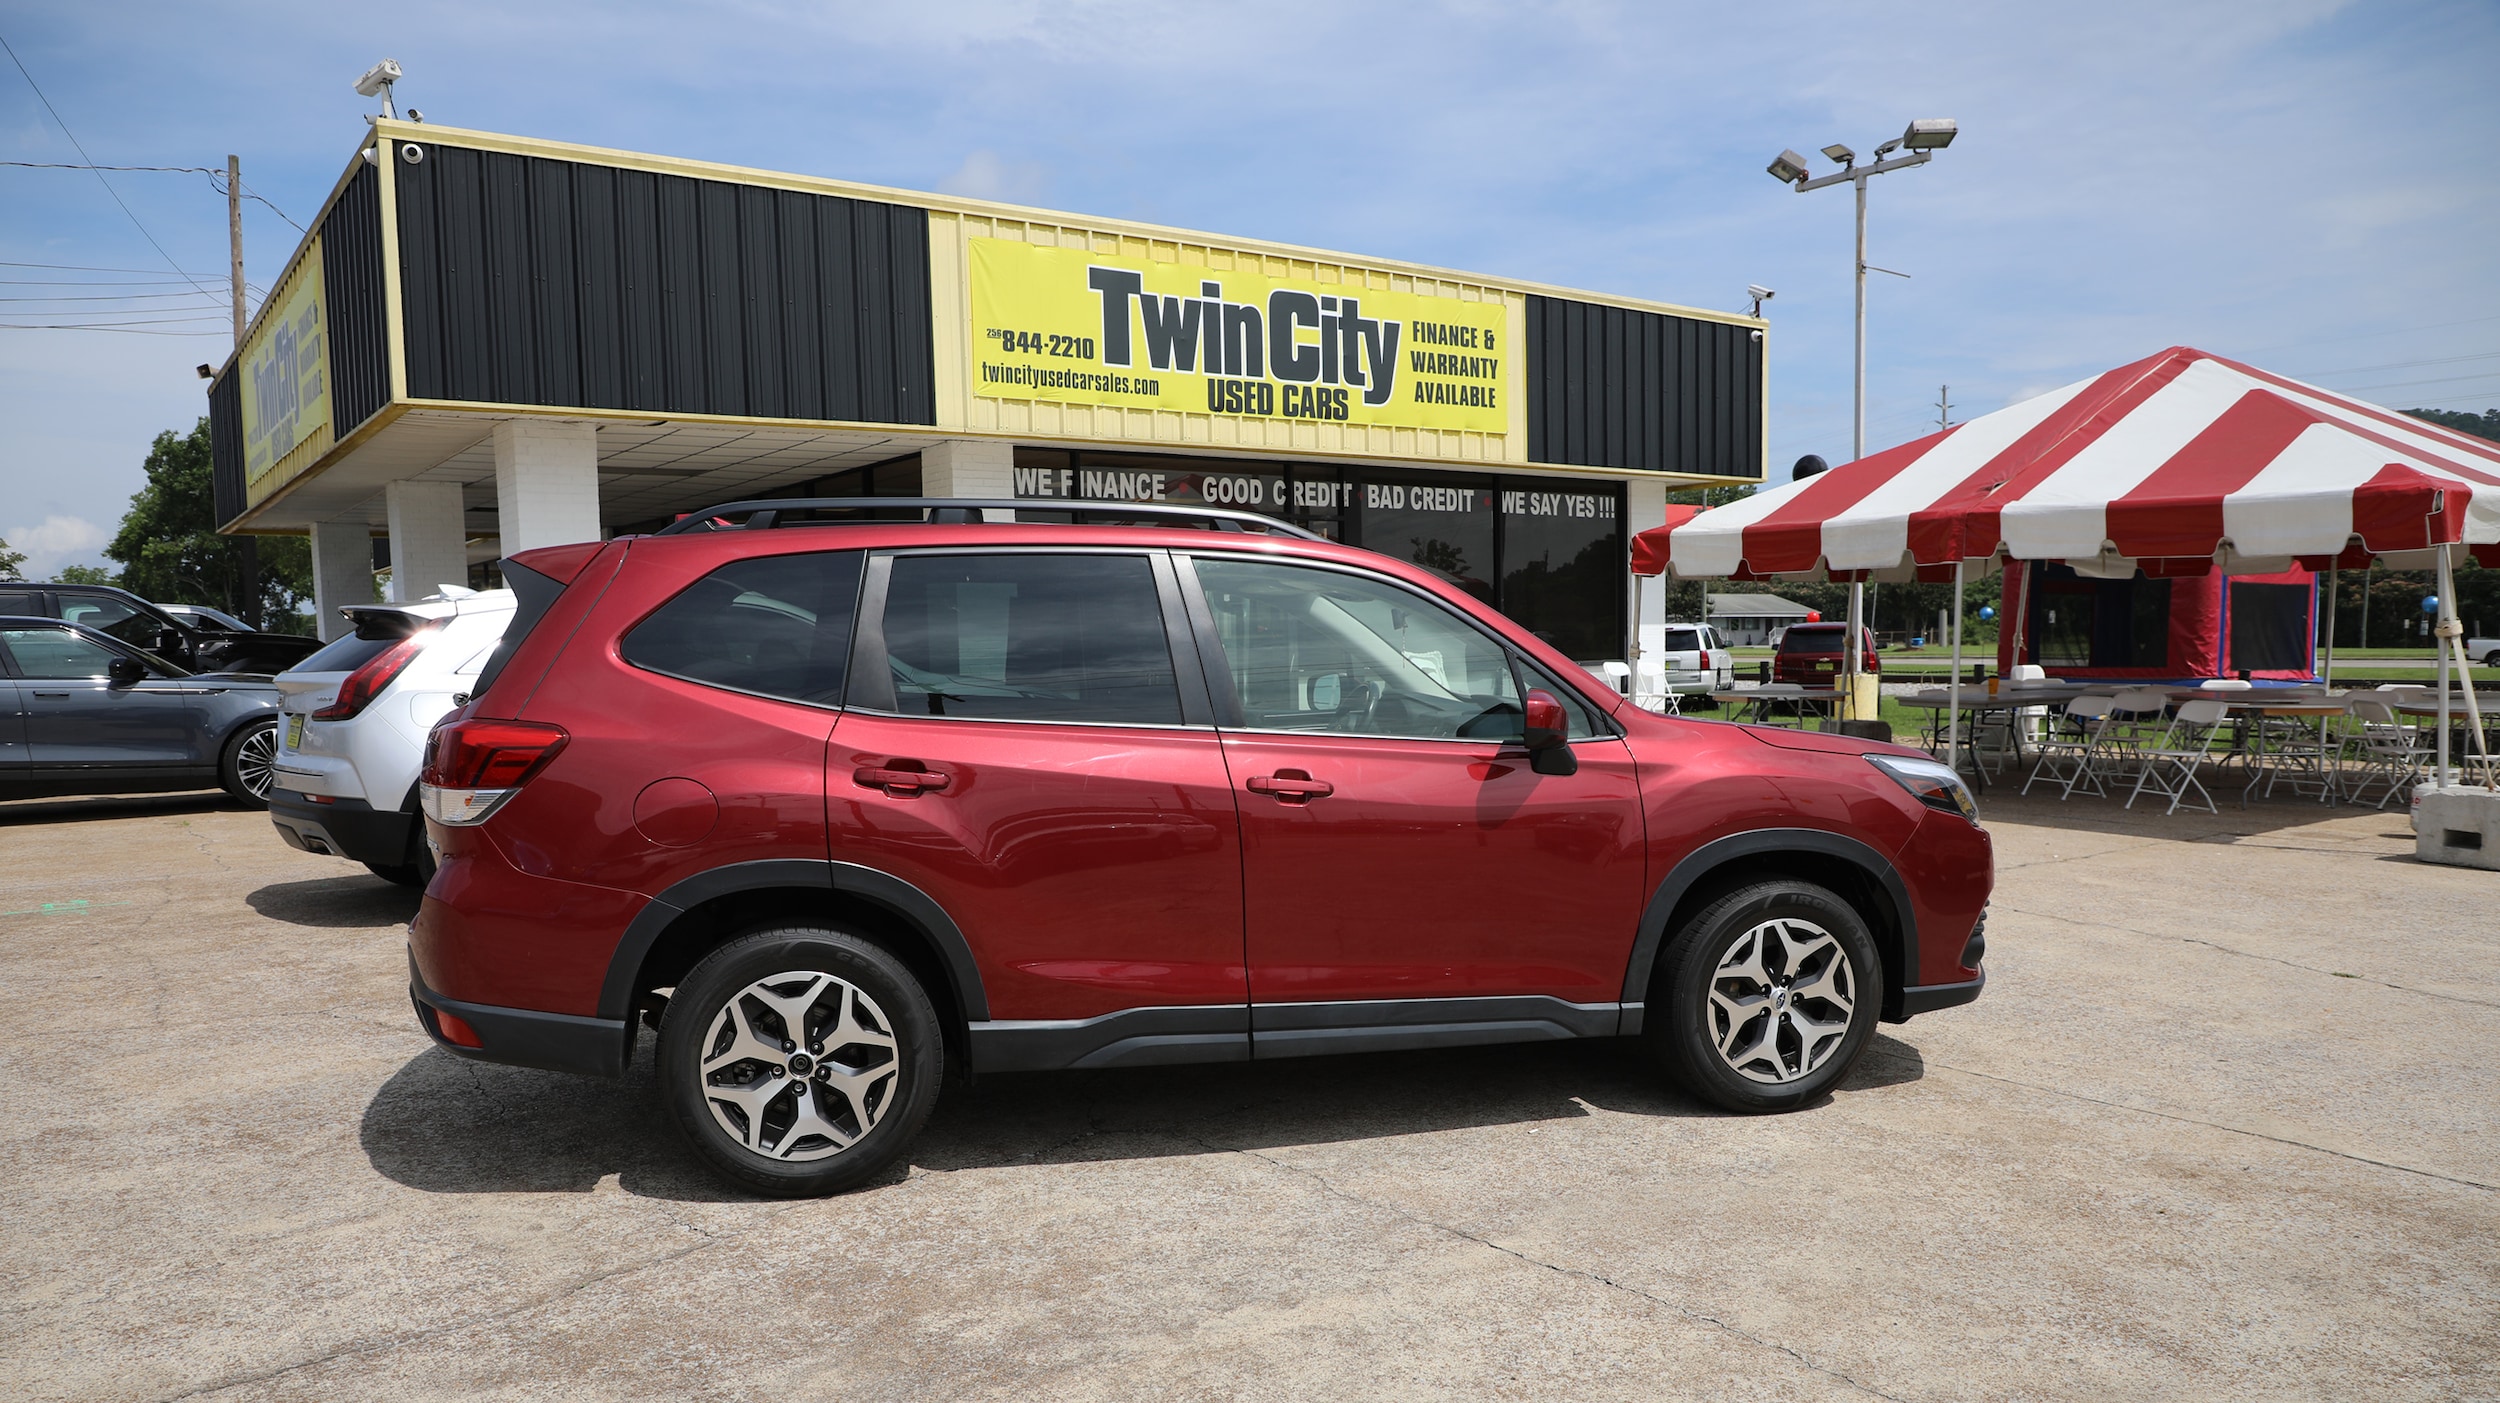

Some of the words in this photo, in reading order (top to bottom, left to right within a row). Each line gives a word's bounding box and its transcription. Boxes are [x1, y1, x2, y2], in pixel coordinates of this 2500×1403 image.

[1002, 330, 1095, 360] 844-2210
[1412, 320, 1478, 348] FINANCE
[1484, 329, 1495, 350] &
[982, 361, 1160, 396] twincityusedcarsales.com
[1410, 350, 1498, 379] WARRANTY
[1207, 378, 1274, 416] USED
[1282, 384, 1349, 421] CARS
[1414, 381, 1496, 408] AVAILABLE
[1014, 467, 1053, 496] WE
[1202, 476, 1264, 504] GOOD
[1367, 484, 1405, 509] BAD
[1410, 486, 1475, 513] CREDIT
[1501, 490, 1526, 515] WE
[1530, 491, 1561, 517] SAY
[1564, 495, 1595, 519] YES
[1599, 496, 1615, 519] !!!
